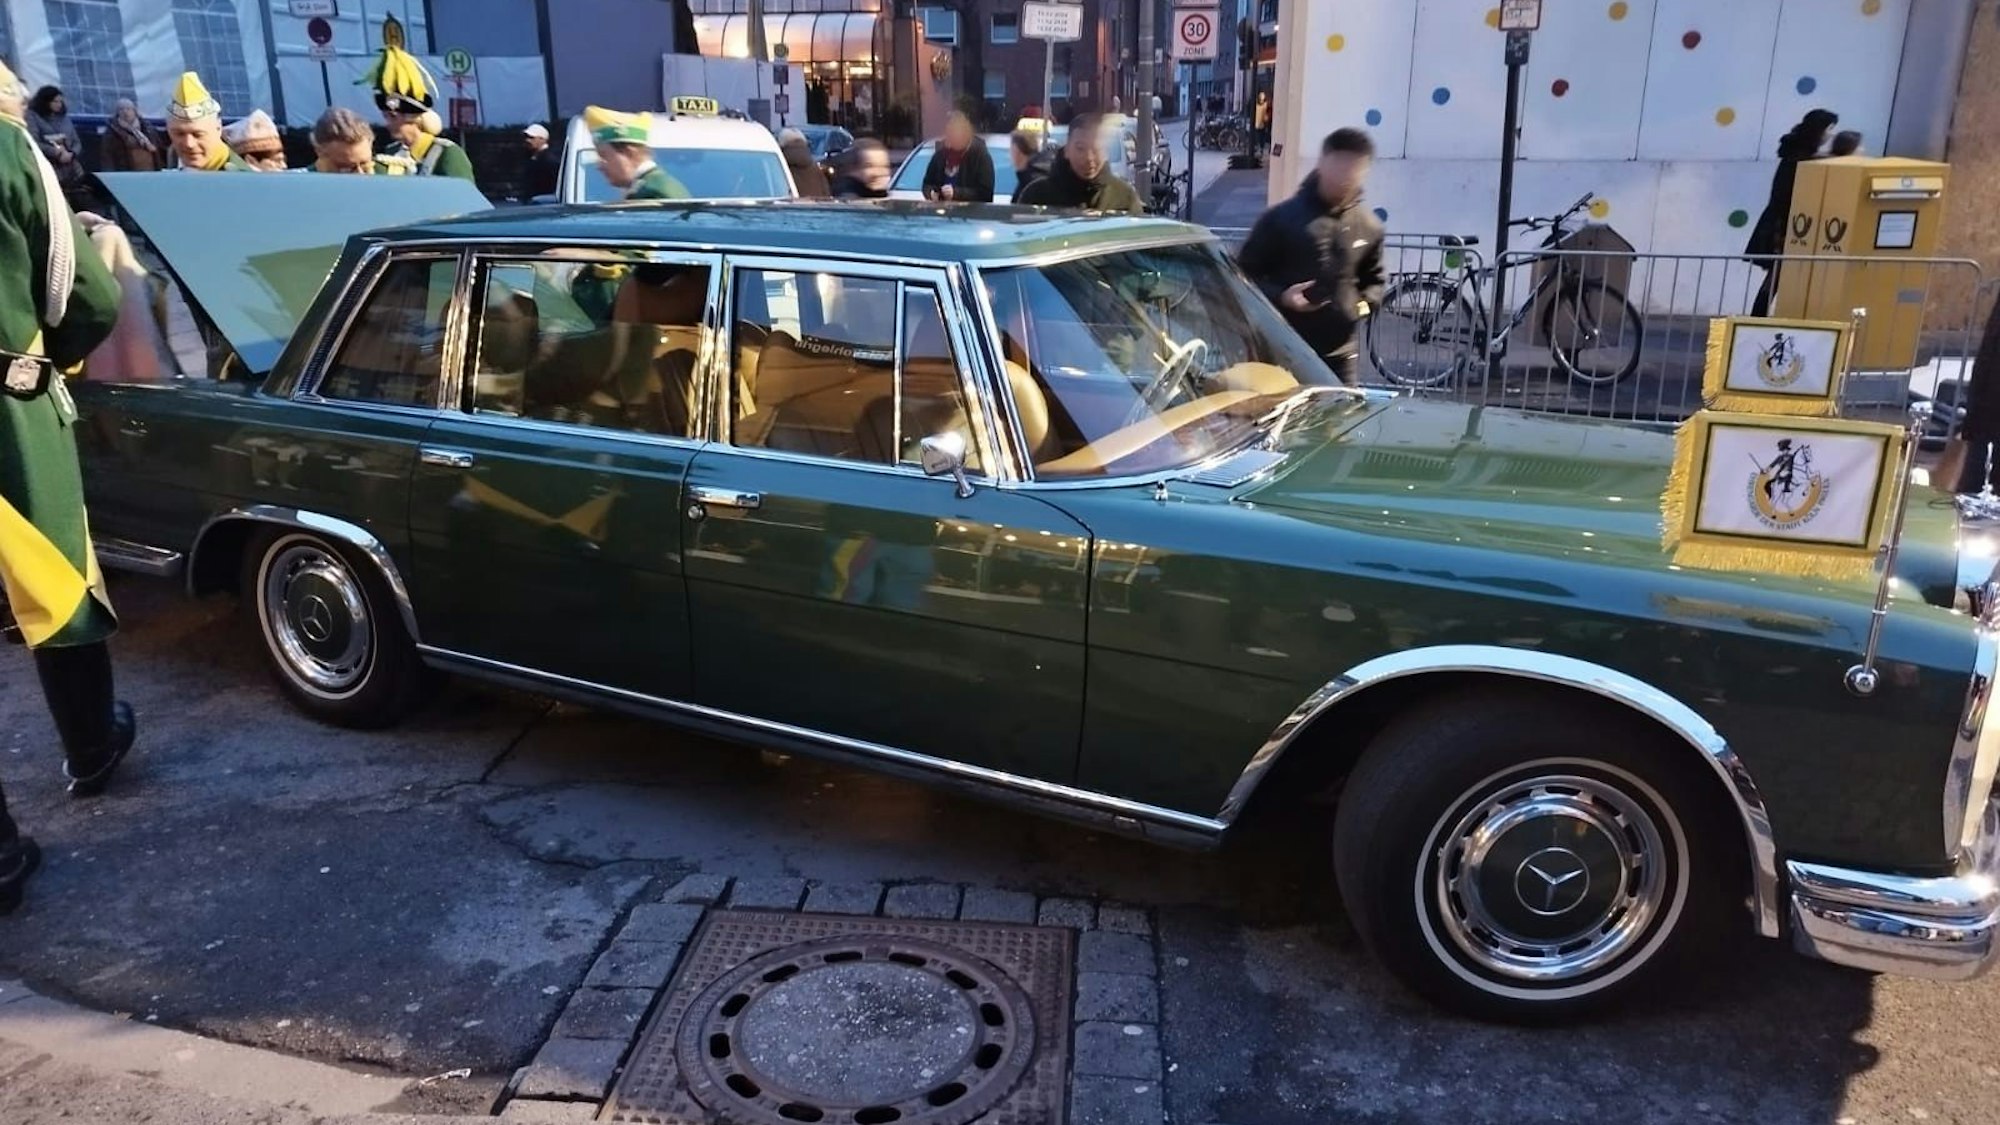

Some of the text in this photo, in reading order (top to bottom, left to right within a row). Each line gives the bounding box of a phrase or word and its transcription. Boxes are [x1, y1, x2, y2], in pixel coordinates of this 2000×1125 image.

[1187, 22, 1204, 37] 30
[1183, 47, 1206, 55] ZONE
[451, 53, 465, 68] H
[679, 99, 711, 111] TAXI
